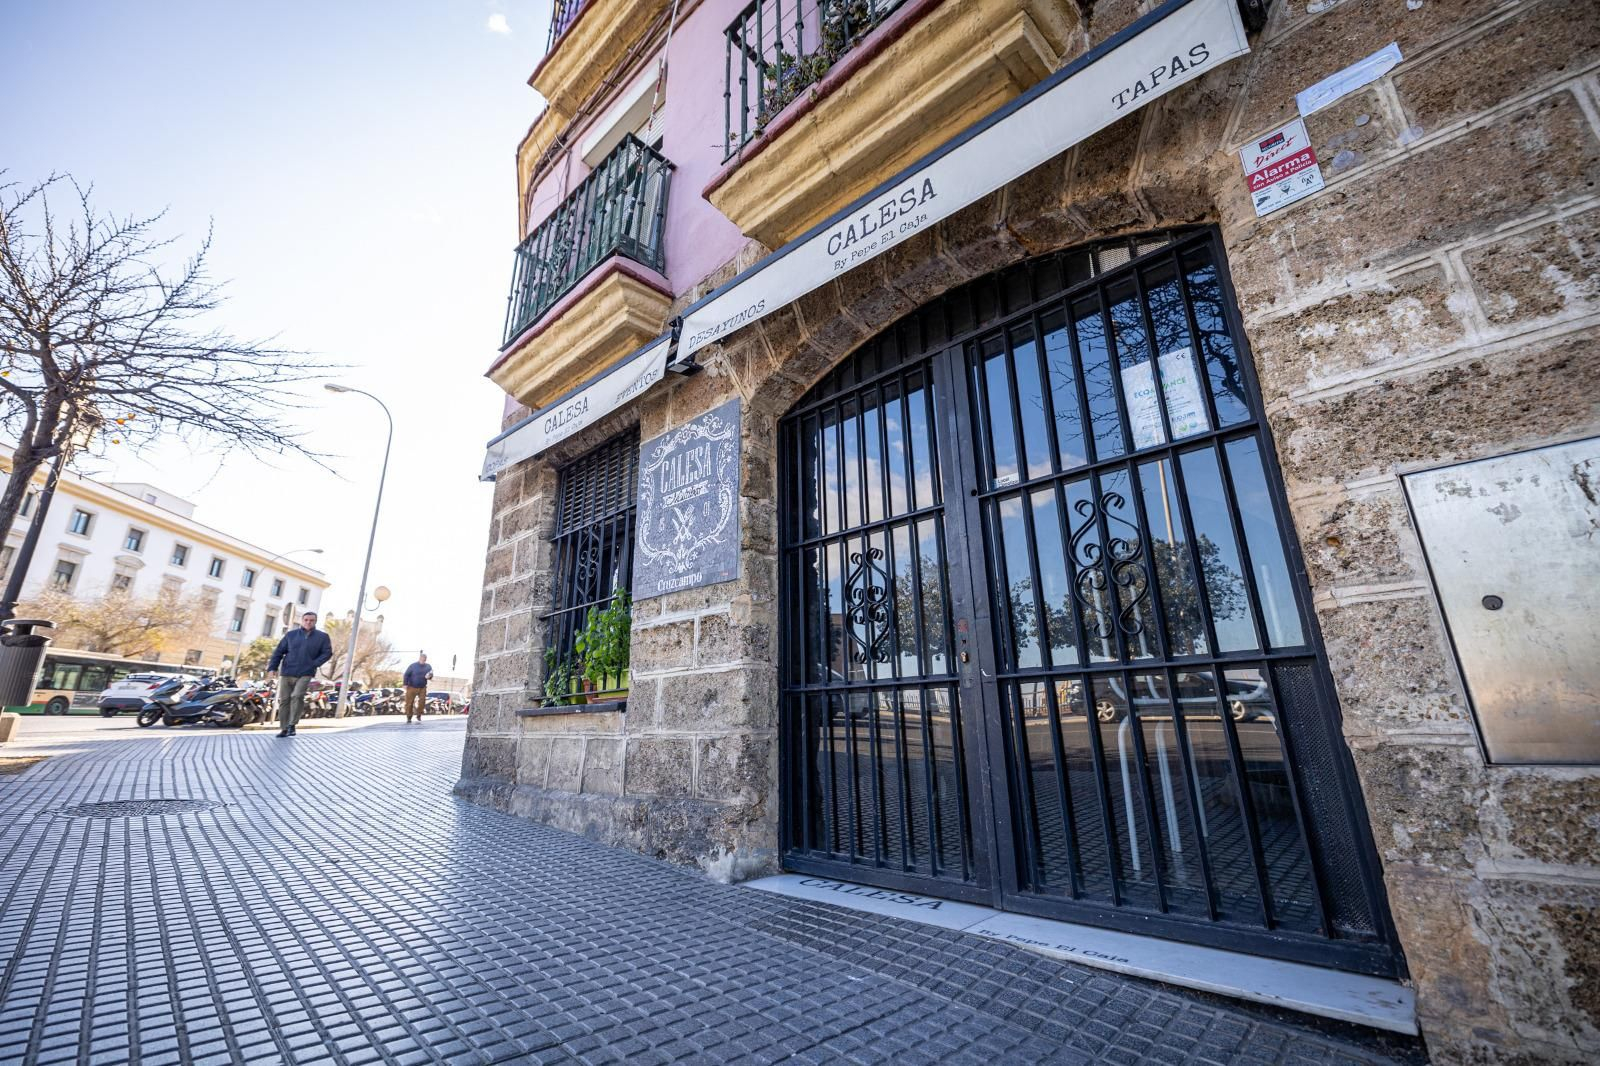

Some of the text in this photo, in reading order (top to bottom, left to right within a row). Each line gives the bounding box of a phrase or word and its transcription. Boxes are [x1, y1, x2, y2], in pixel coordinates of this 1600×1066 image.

[1111, 42, 1210, 110] TAPAS
[1252, 134, 1297, 168] Direct
[1252, 153, 1311, 185] Alarma
[1253, 182, 1266, 190] con
[1267, 173, 1284, 185] Aviso
[827, 177, 938, 256] CALESA
[833, 213, 929, 271] By Pepe El Caja
[688, 299, 766, 349] DESAYUNOS
[614, 368, 659, 405] EVENTOS
[544, 396, 590, 435] CALESA
[660, 442, 712, 495] CALESA
[657, 572, 703, 593] Cruzcampo
[799, 878, 945, 911] CALESA
[978, 929, 1130, 964] By Pepe El Caja
